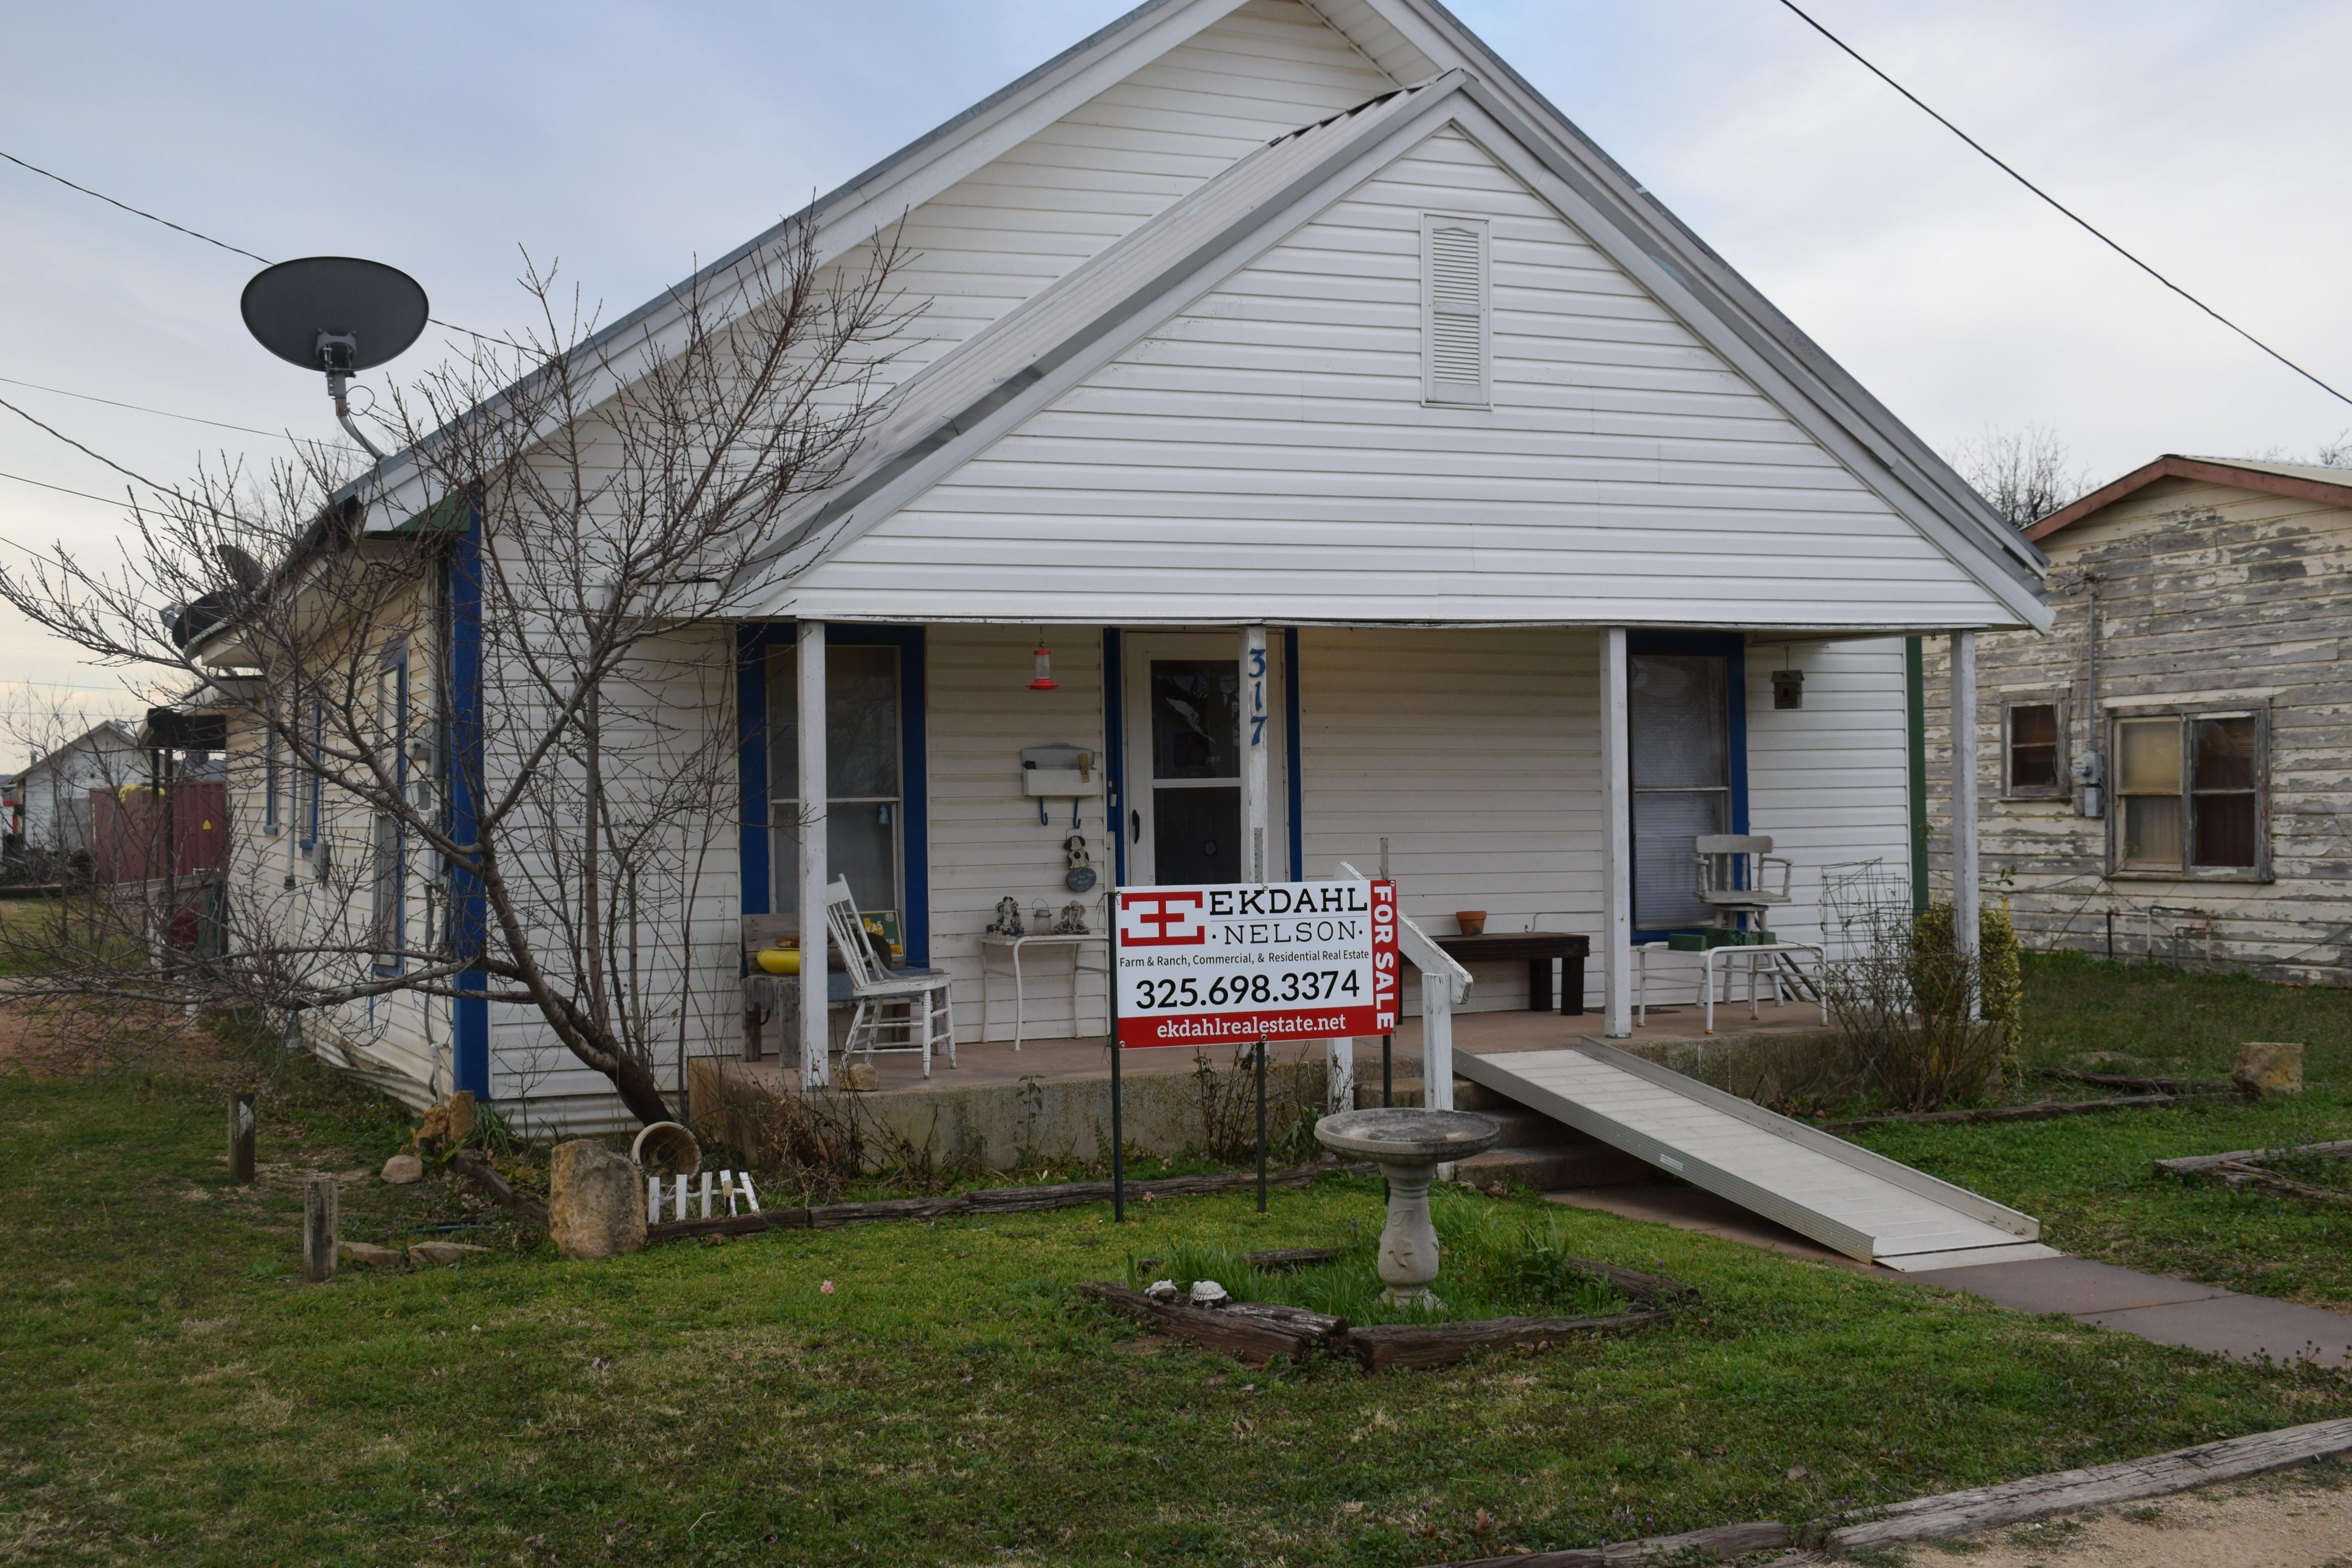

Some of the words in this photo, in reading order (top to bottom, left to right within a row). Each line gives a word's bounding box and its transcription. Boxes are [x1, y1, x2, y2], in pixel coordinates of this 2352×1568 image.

[1249, 648, 1268, 746] 317
[1210, 887, 1367, 915] EKDAHL
[1374, 886, 1393, 944] FOR
[1224, 920, 1356, 945] NELSON
[1120, 958, 1144, 967] Farm
[1147, 956, 1154, 966] &
[1157, 955, 1190, 967] Ranch,
[1193, 953, 1254, 965] Commercial,
[1258, 953, 1264, 962] &
[1269, 951, 1320, 962] Residential
[1323, 949, 1341, 960] Real
[1344, 949, 1369, 959] Estate
[1136, 969, 1359, 1009] 325.698.3374
[1375, 952, 1394, 1029] SALE
[1157, 1014, 1346, 1038] ekdahlrealestate.net
